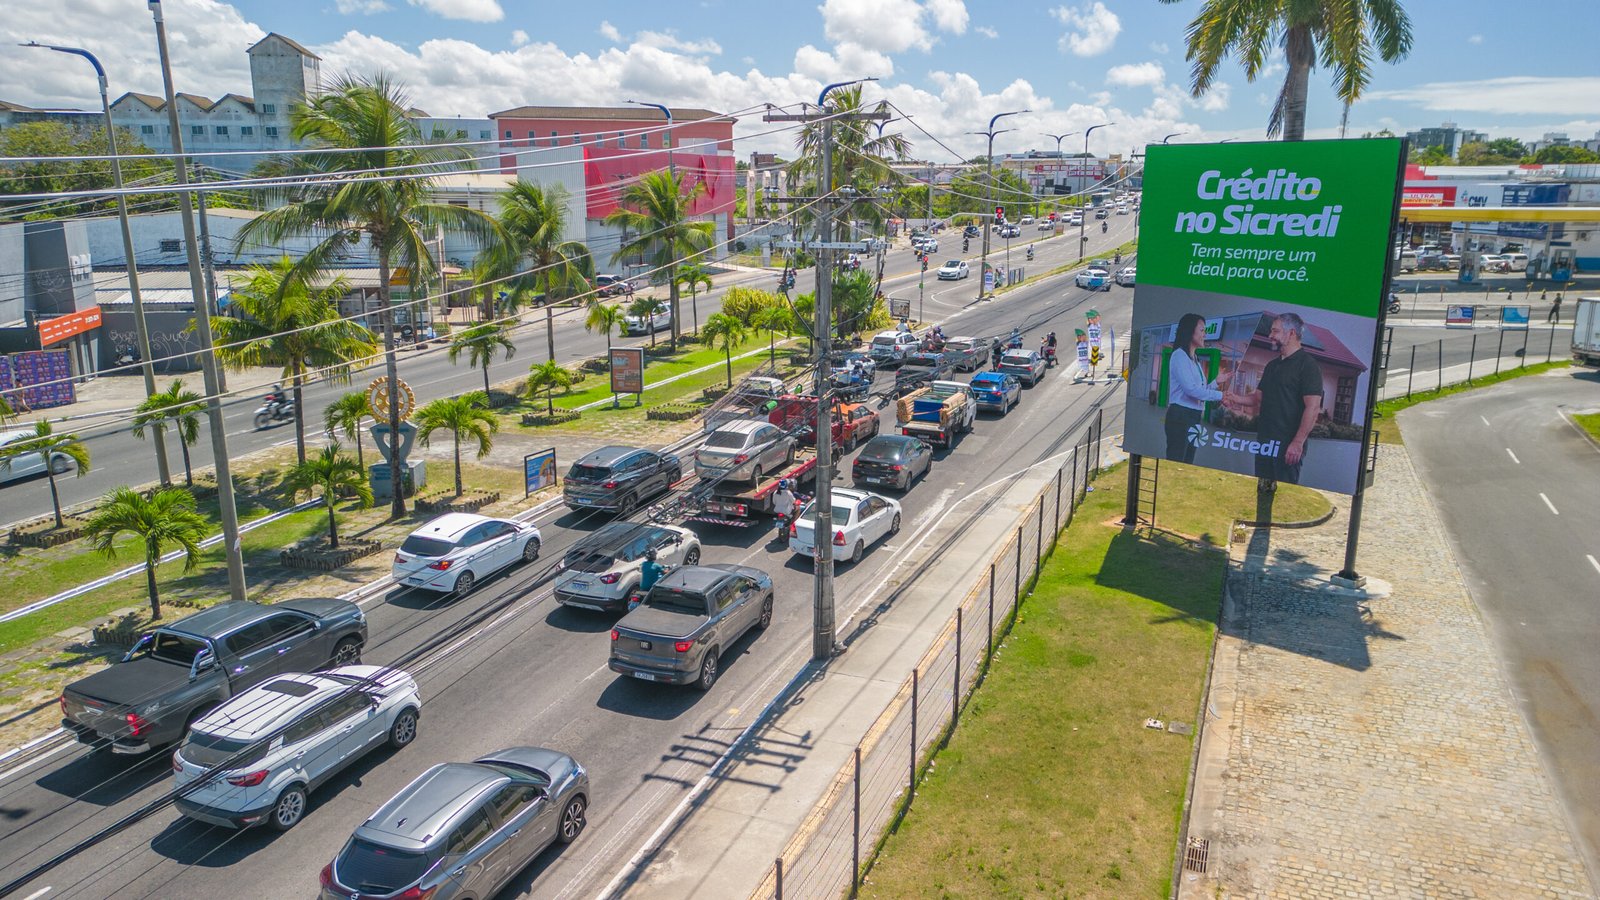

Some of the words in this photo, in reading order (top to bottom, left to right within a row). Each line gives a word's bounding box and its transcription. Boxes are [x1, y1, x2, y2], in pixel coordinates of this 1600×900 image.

[1197, 168, 1322, 201] Crédito
[1175, 211, 1217, 234] no
[1220, 204, 1343, 237] Sicredi
[1192, 243, 1221, 258] Tem
[1225, 247, 1285, 263] sempre
[1289, 251, 1316, 262] um
[1188, 262, 1225, 277] ideal
[1227, 266, 1264, 280] para
[1268, 267, 1309, 282] você.
[1211, 430, 1281, 458] Sicredi
